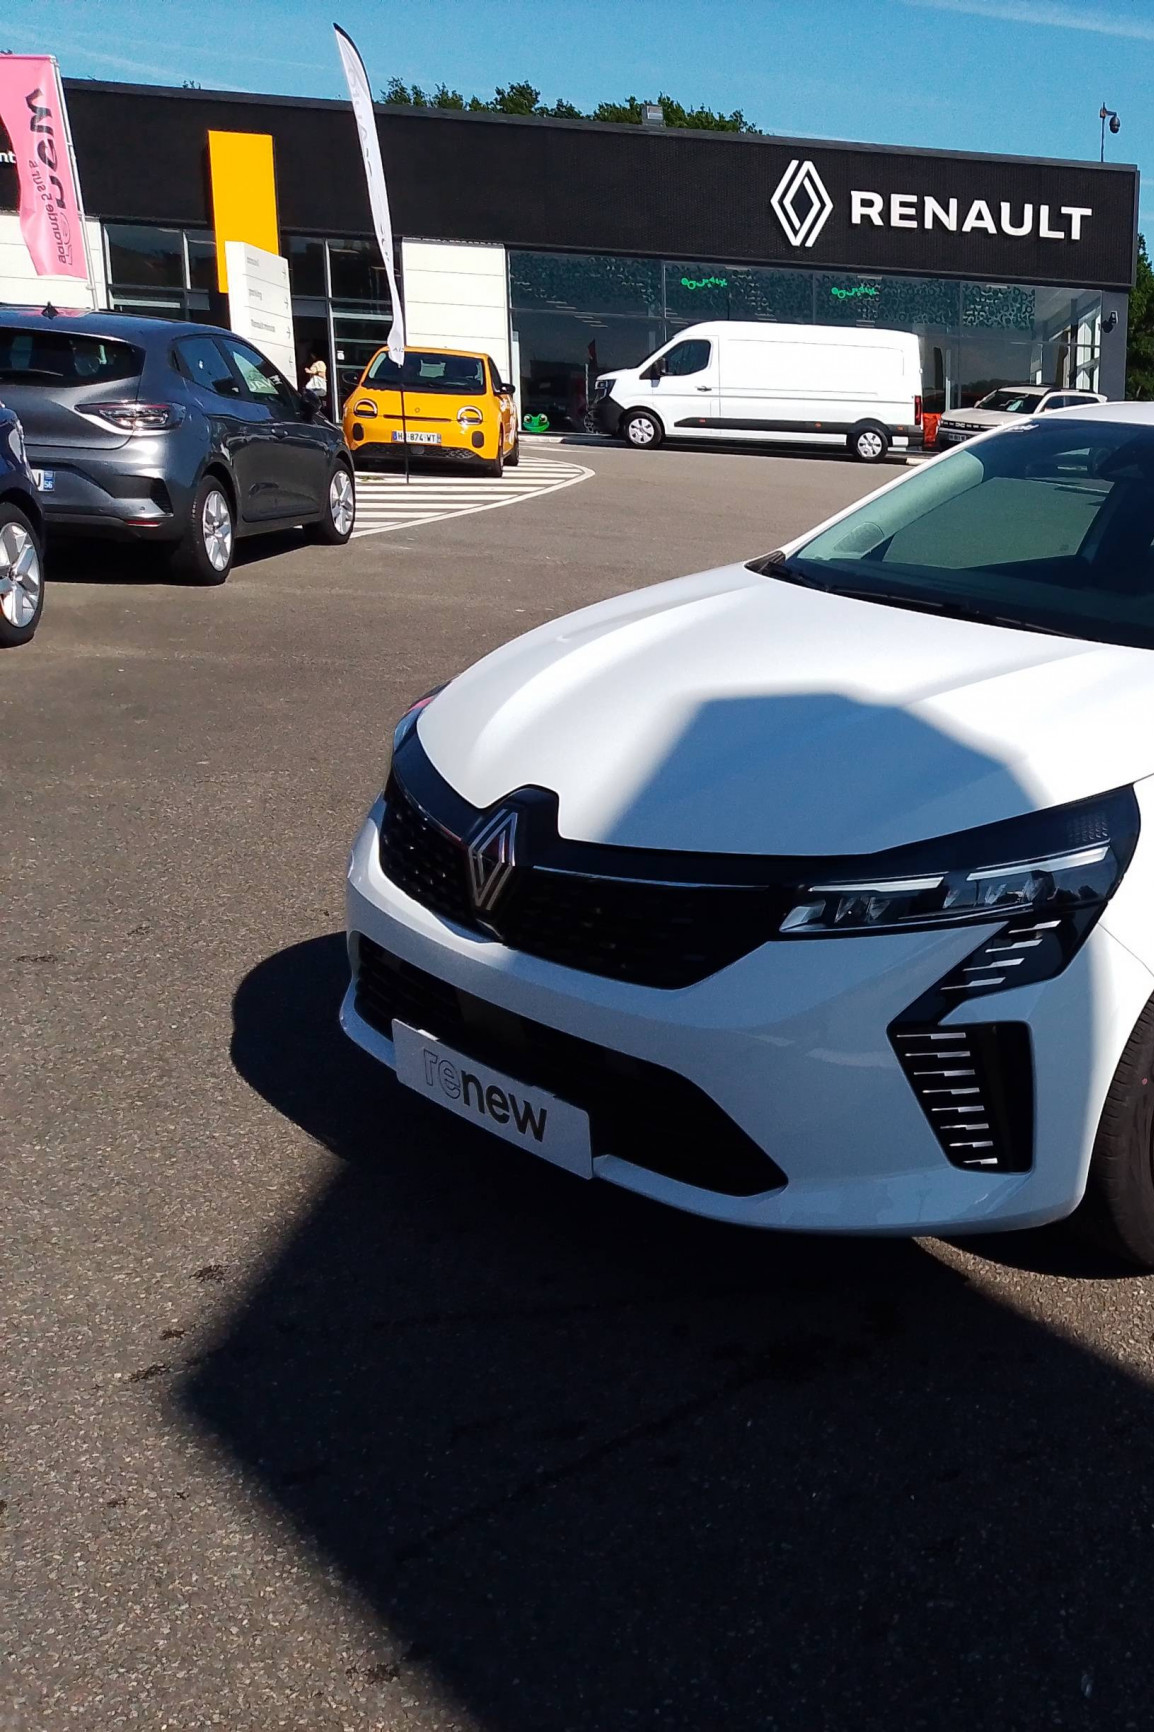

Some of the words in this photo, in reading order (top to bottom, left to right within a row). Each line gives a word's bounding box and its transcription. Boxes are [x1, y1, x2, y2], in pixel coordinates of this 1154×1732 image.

[850, 190, 1093, 241] RENAULT
[44, 480, 53, 489] 56
[423, 1047, 548, 1143] renew
